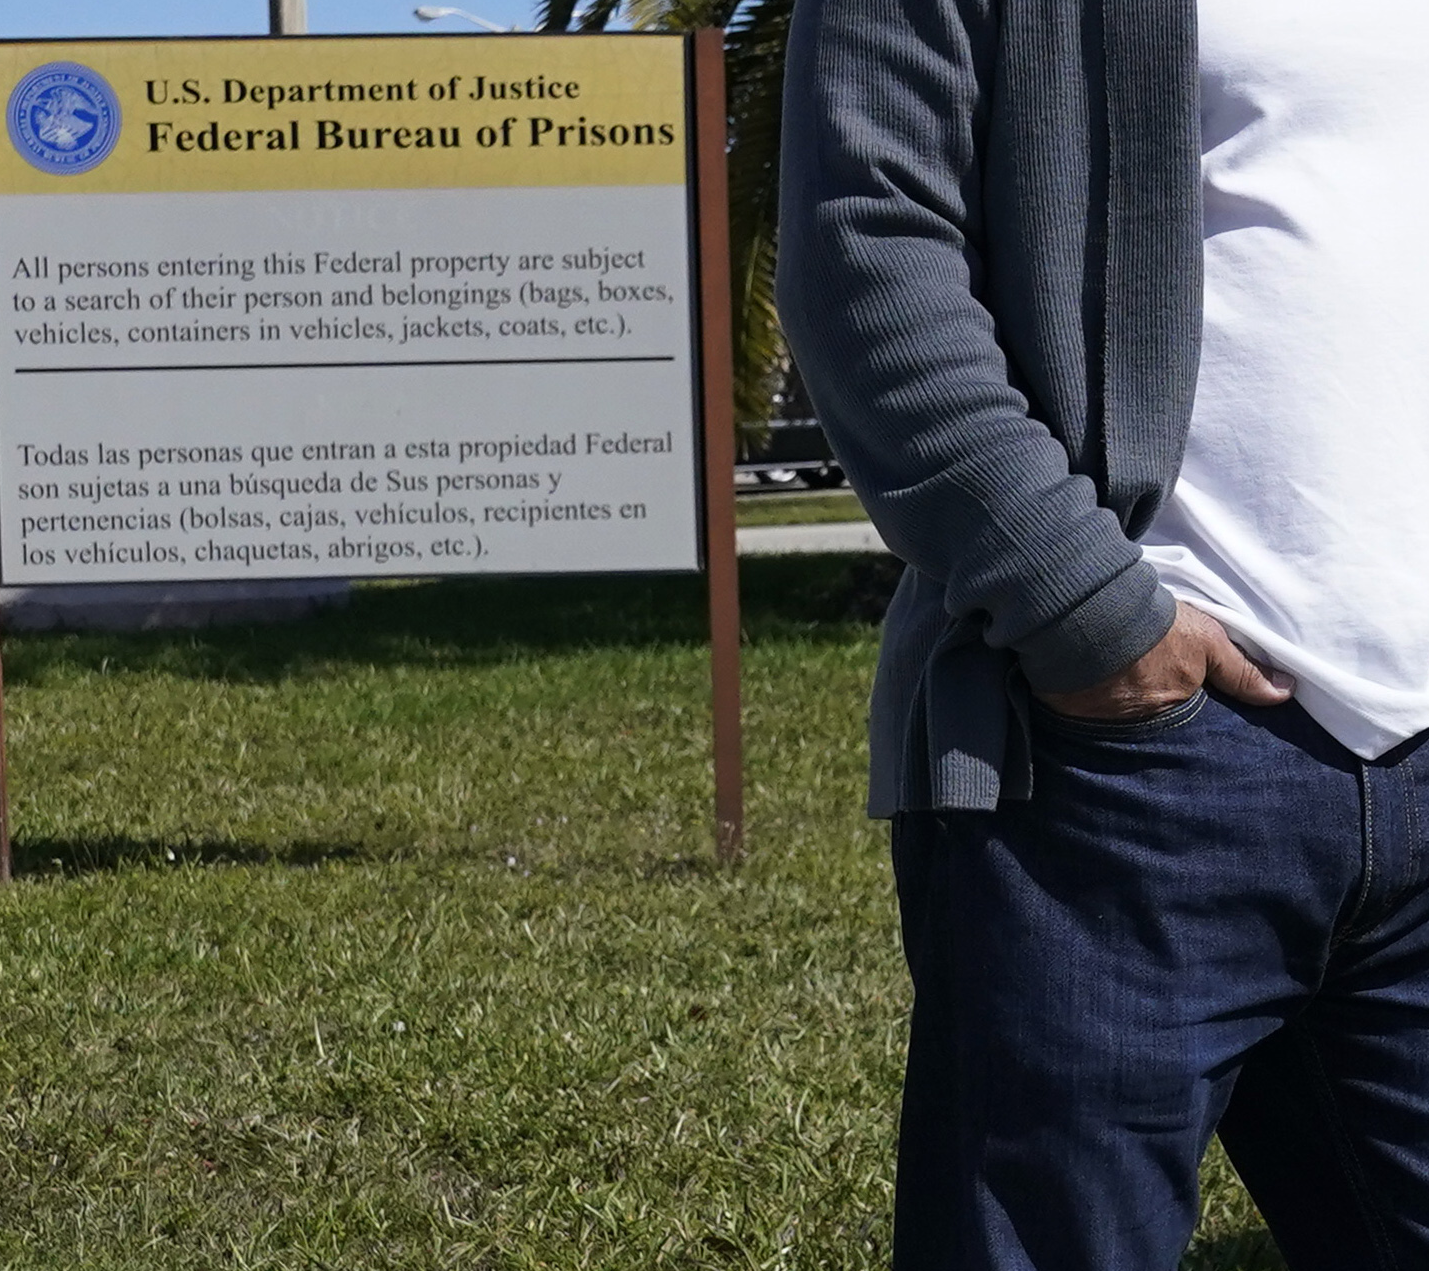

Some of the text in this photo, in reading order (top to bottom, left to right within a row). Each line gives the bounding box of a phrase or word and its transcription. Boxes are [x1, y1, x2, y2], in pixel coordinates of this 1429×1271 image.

[144, 73, 581, 111] U.S. Department of Justice
[145, 115, 676, 154] Federal Bureau of Prisons
[11, 246, 646, 286] All persons entering this Federal property are subject
[12, 279, 675, 316] to a search of their person and belongings (bags, boxes,
[13, 314, 633, 348] vehicles, containers in vehicles, jackets, coats, etc.).
[16, 429, 673, 471] Todas las personas que entran a esta propiedad Federal
[17, 469, 563, 506] son sujetas a una búsqueda de Sus personas y
[20, 498, 647, 540] pertenencias (bolsas, cajas, vehículos, recipientes en
[21, 534, 489, 568] los vehículos, chaquetas, abrigos, etc.).
